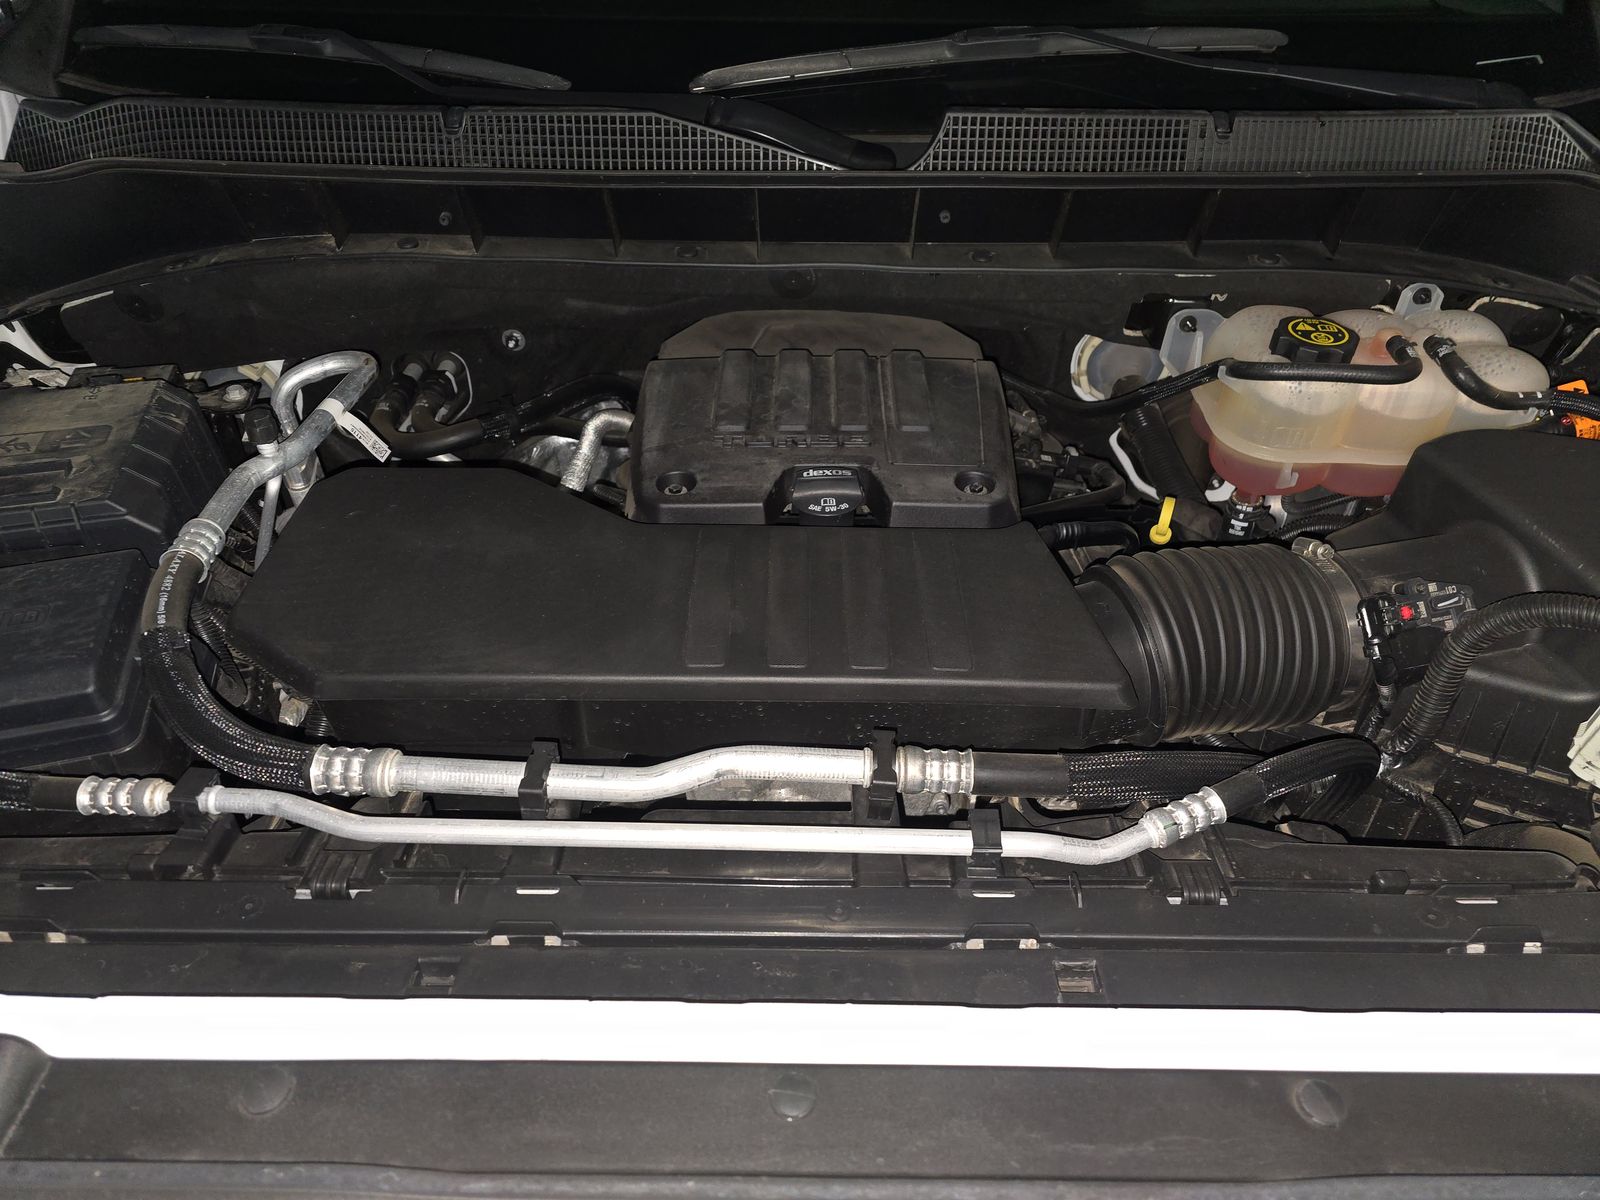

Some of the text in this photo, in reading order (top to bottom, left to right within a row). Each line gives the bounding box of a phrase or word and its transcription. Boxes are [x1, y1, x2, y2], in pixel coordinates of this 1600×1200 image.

[802, 468, 852, 478] dexos
[808, 502, 849, 513] SAE 5W-30
